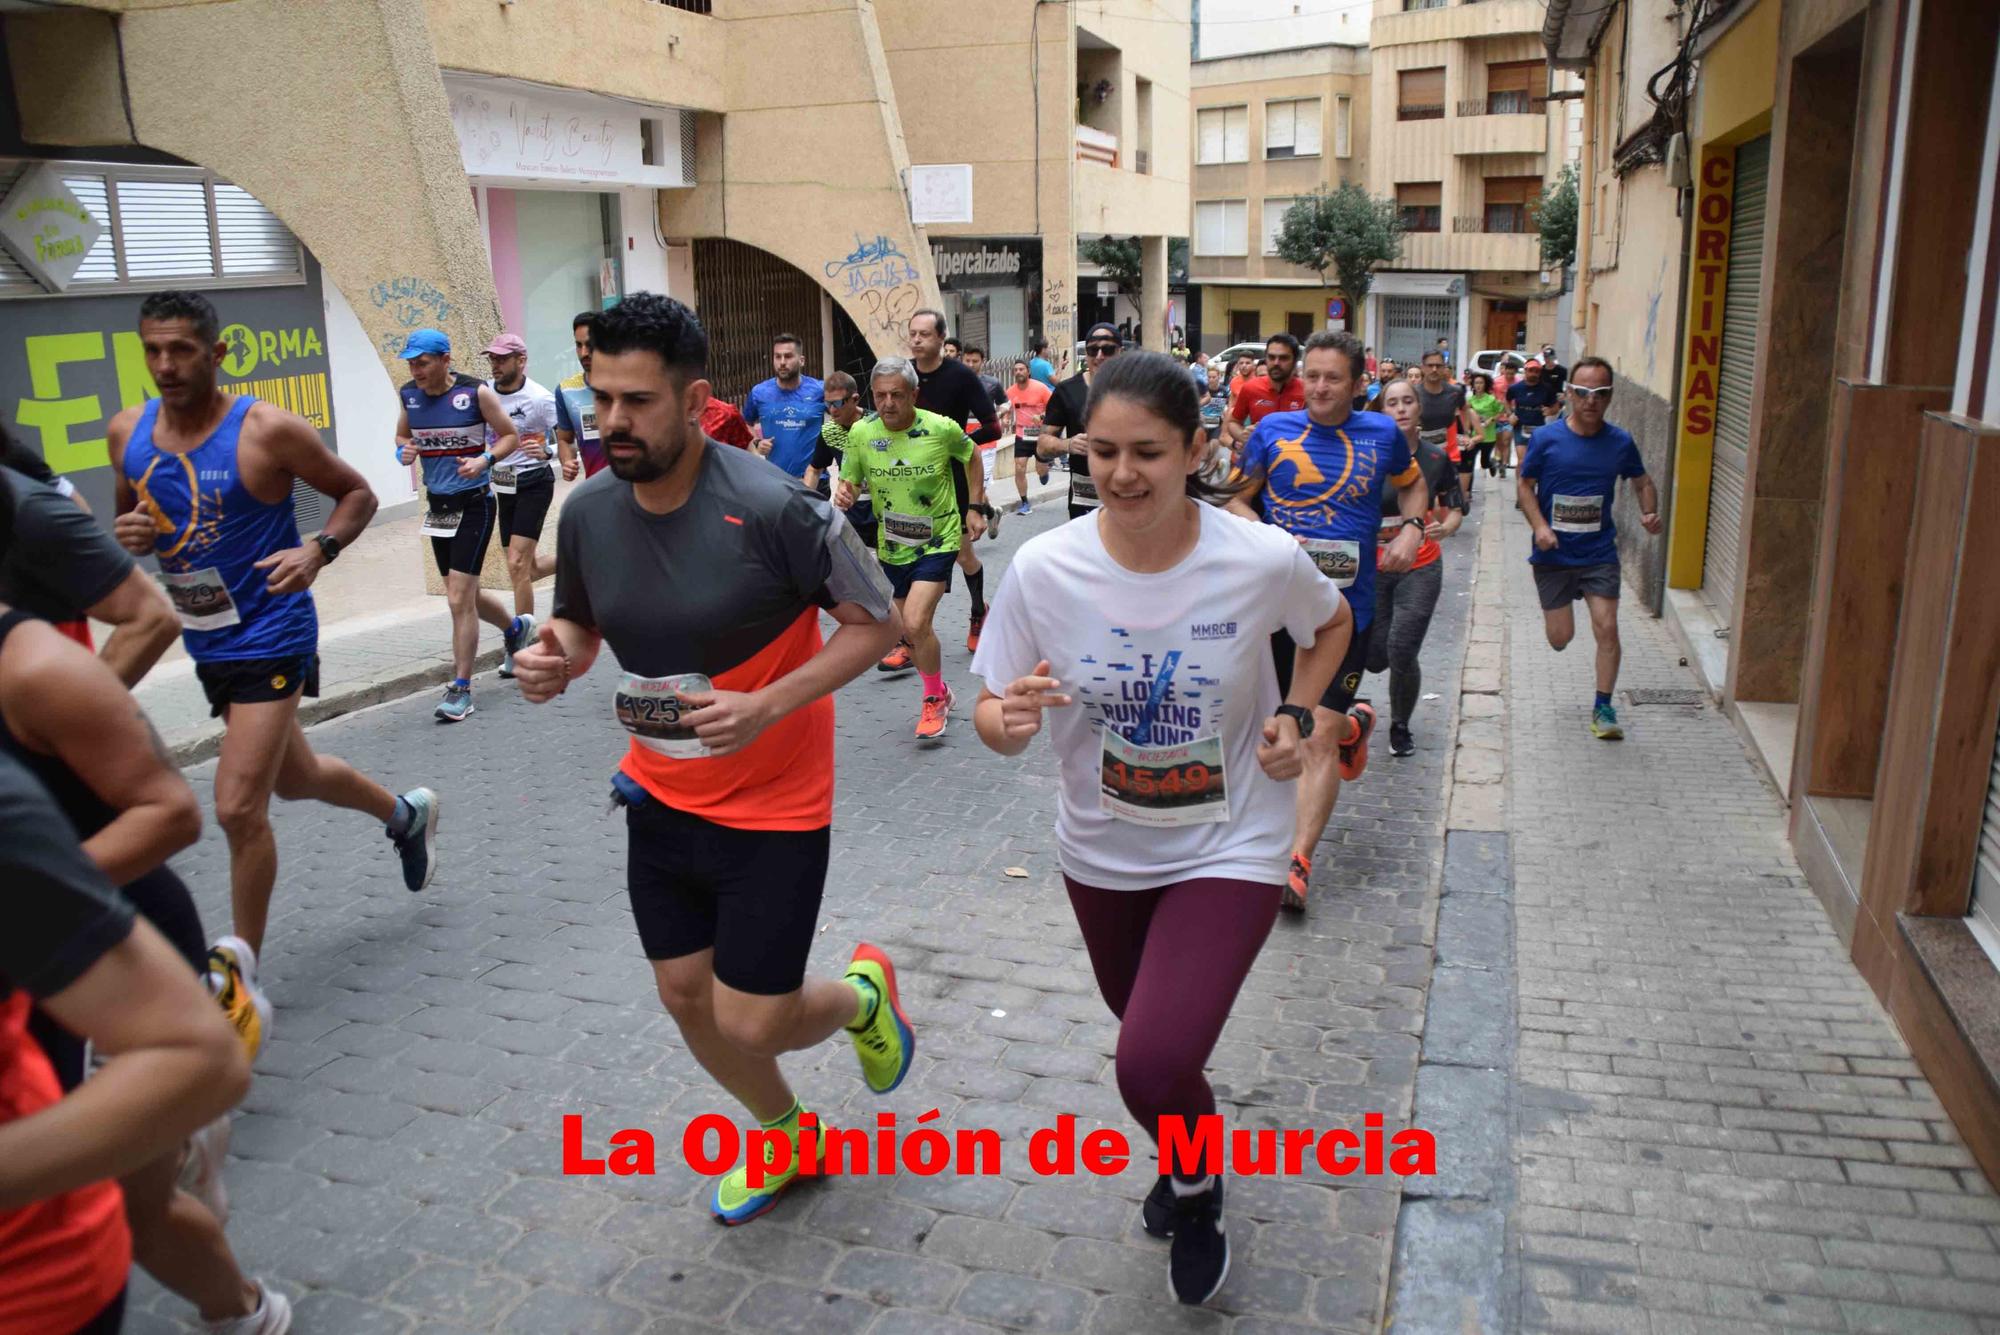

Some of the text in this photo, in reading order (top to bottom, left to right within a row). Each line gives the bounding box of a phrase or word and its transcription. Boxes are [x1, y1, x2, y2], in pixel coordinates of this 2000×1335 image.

[1686, 157, 1730, 435] CORTINAS
[869, 464, 936, 477] FONDISTAS
[1311, 552, 1350, 569] 132
[1141, 654, 1153, 678] I
[1101, 704, 1201, 729] RUNNING
[1112, 762, 1210, 794] 1549
